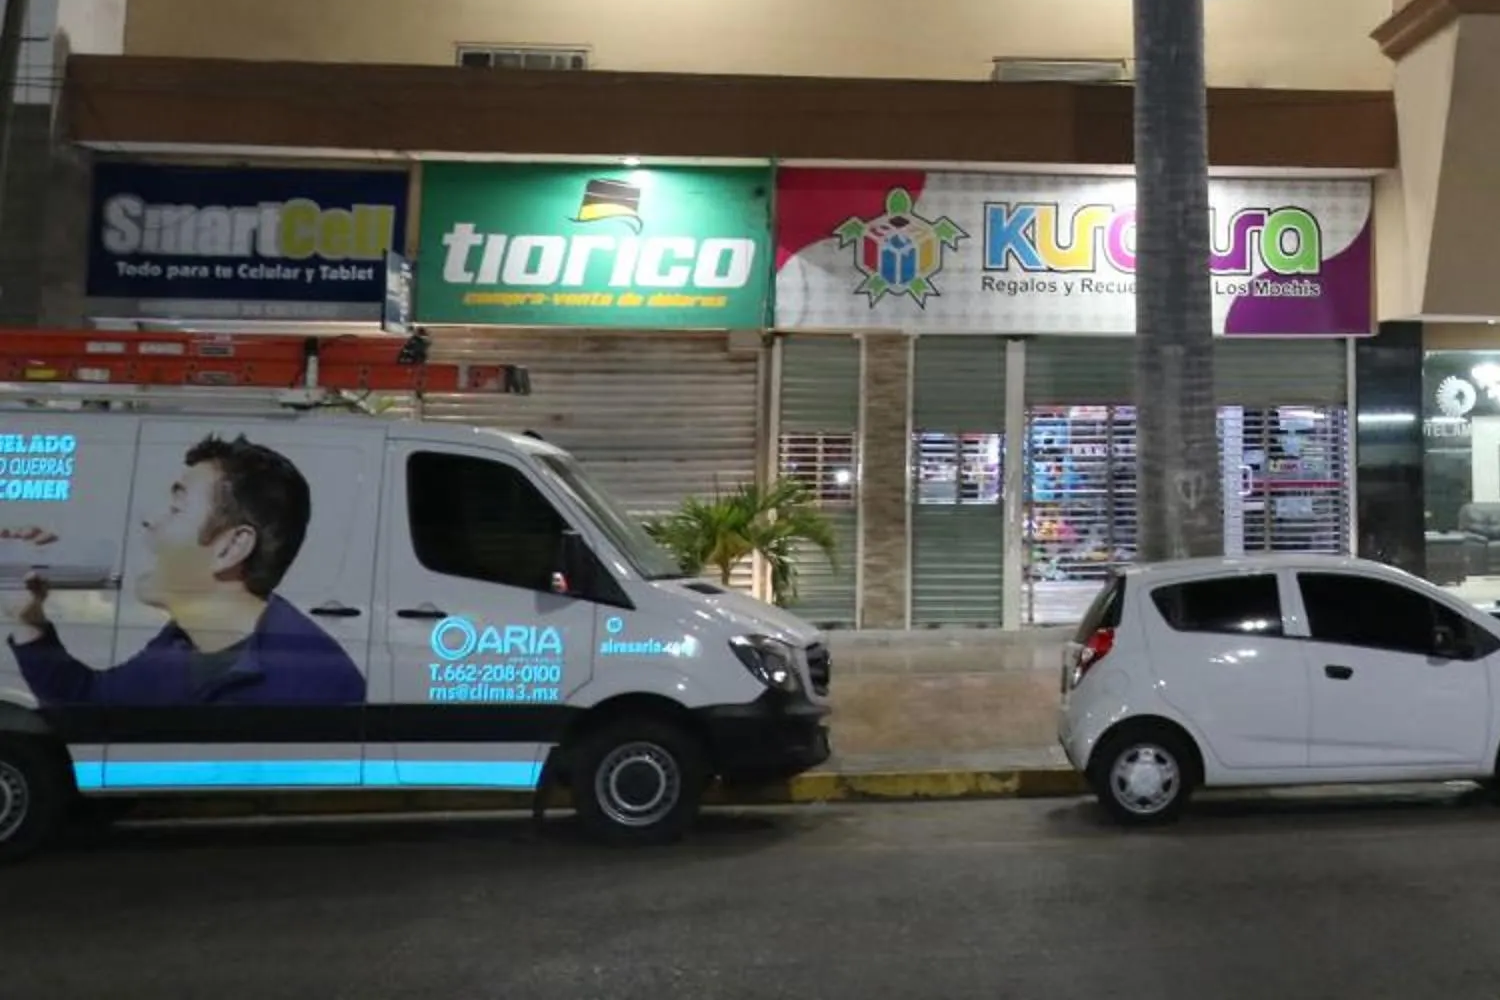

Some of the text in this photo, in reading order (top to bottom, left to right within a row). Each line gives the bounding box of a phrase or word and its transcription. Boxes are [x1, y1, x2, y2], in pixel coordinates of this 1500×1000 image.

[103, 193, 396, 260] SmartCell
[115, 261, 375, 284] Todo para tu Celular y Tablet
[981, 276, 1322, 298] Regalos y Recue Los Mochis
